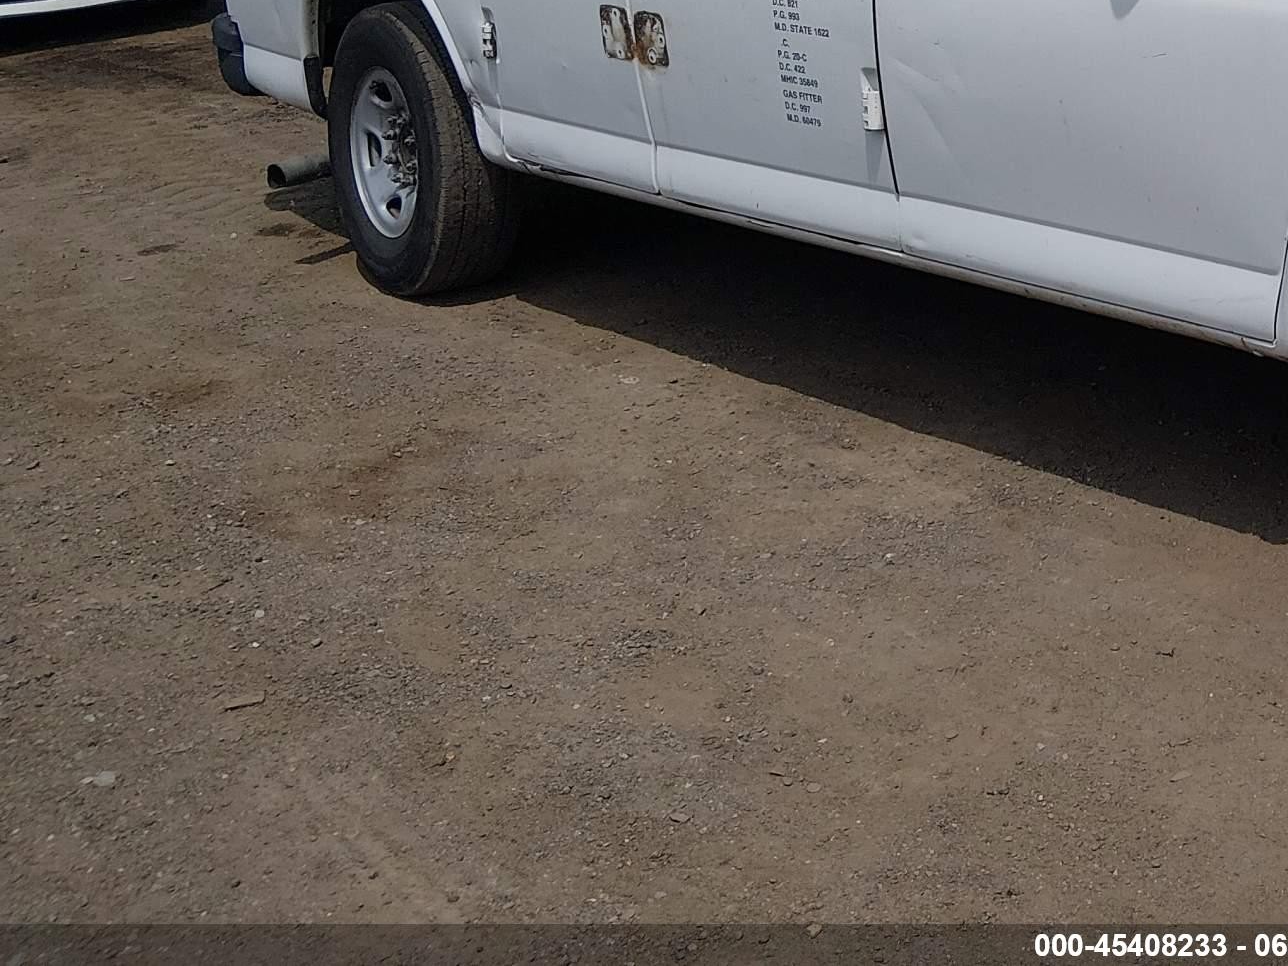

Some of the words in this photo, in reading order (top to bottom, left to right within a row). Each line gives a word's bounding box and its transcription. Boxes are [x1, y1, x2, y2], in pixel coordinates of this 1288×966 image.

[790, 24, 813, 35] STATE
[783, 89, 798, 99] GAS
[799, 92, 823, 104] FITTER
